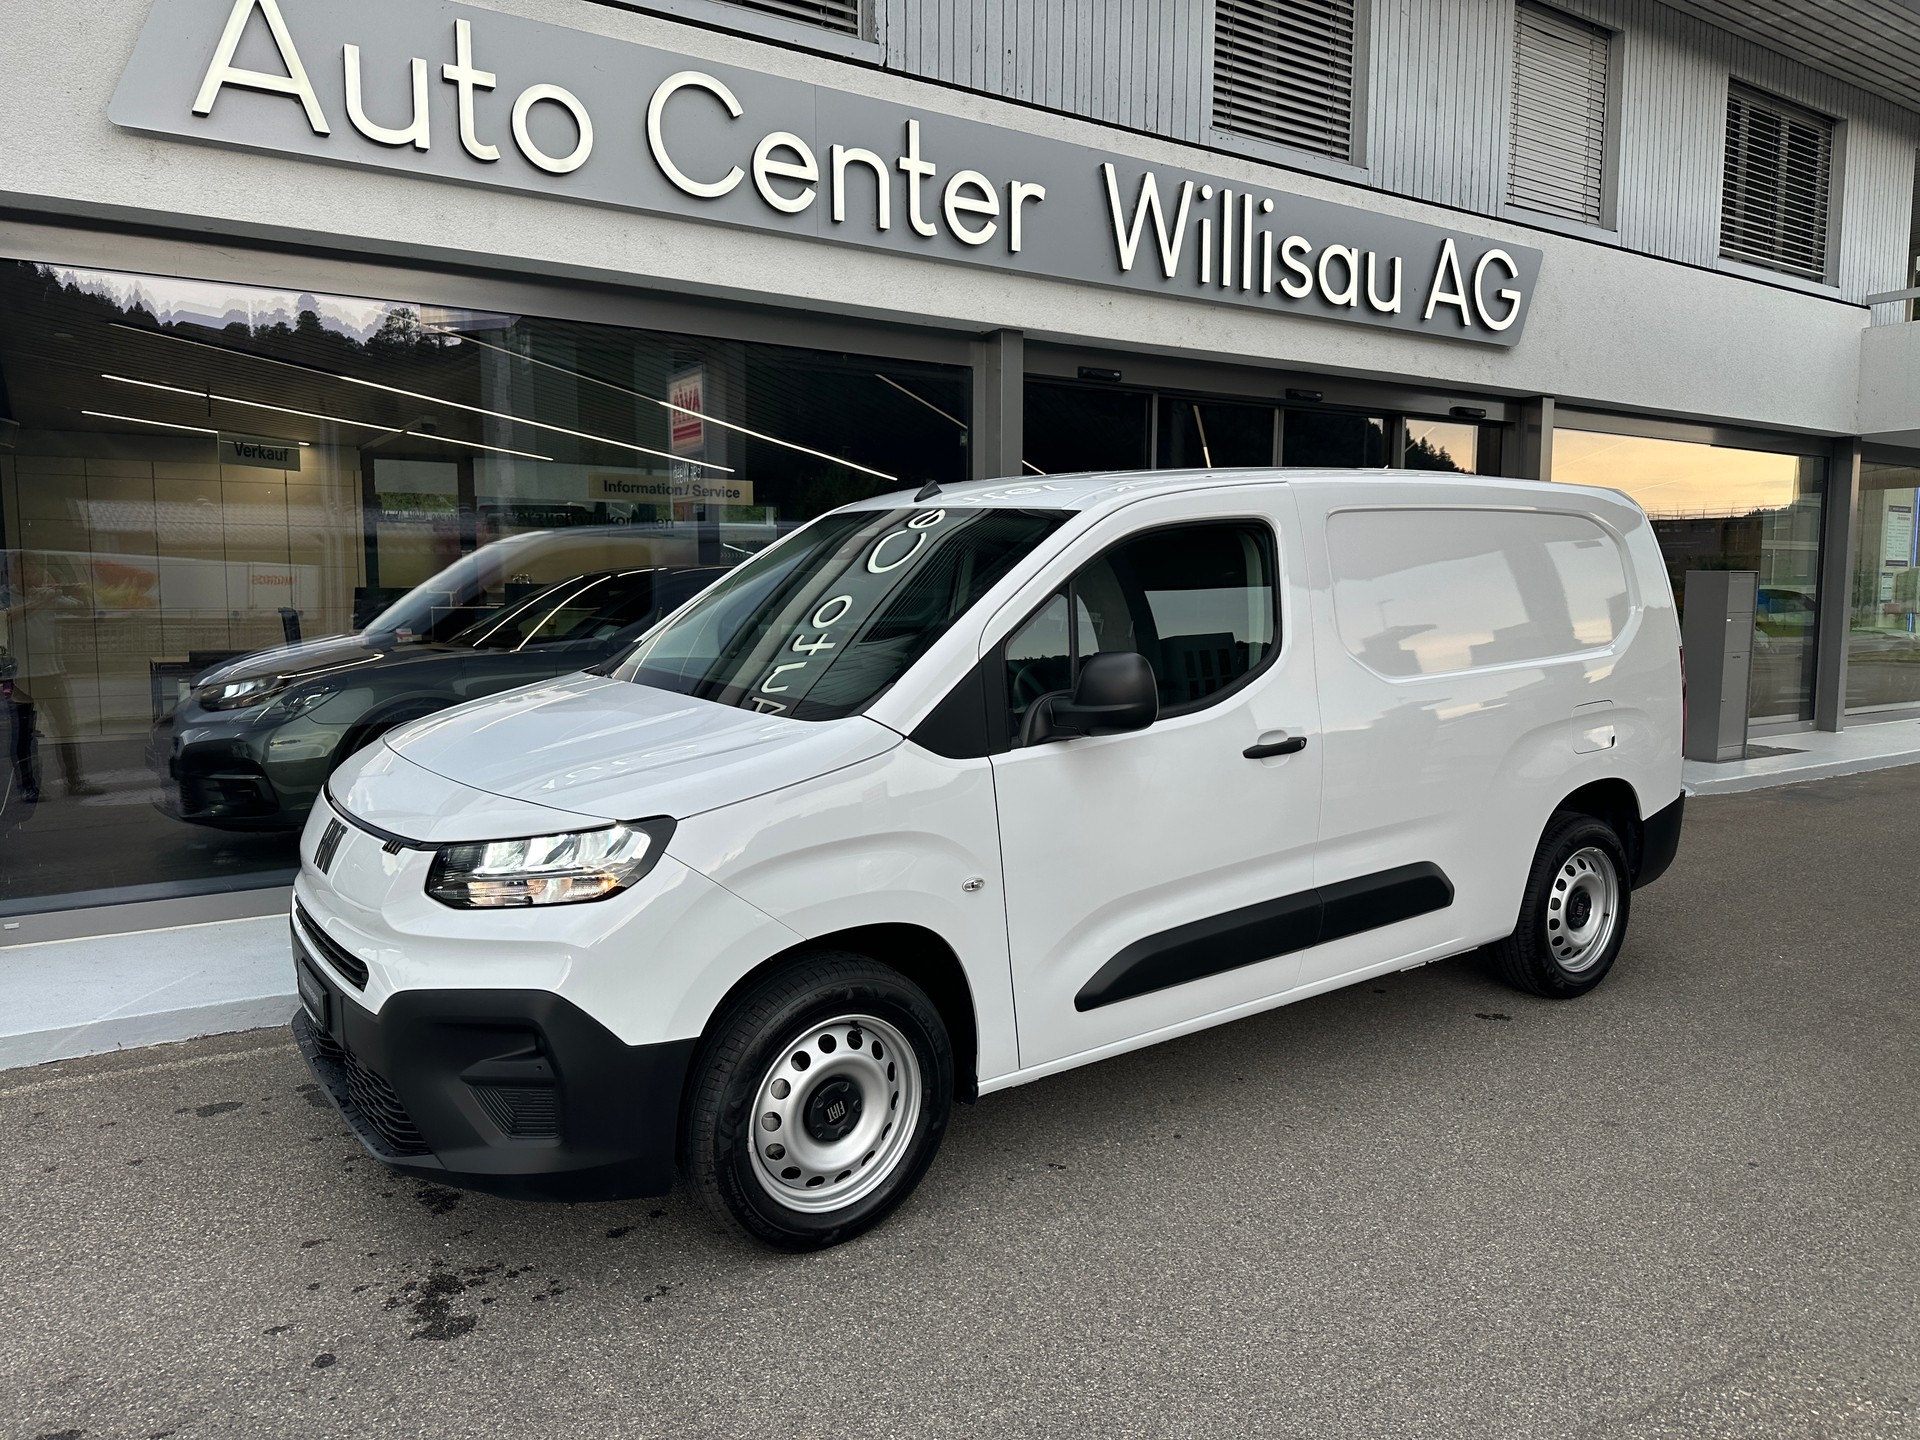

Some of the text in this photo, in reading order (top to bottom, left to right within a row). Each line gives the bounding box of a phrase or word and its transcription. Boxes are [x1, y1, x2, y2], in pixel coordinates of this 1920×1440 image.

[191, 0, 1523, 332] Auto Center Willisau AG
[234, 441, 289, 462] Verkauf
[604, 480, 682, 496] Information
[692, 484, 741, 499] Service
[827, 1100, 846, 1123] FIAT
